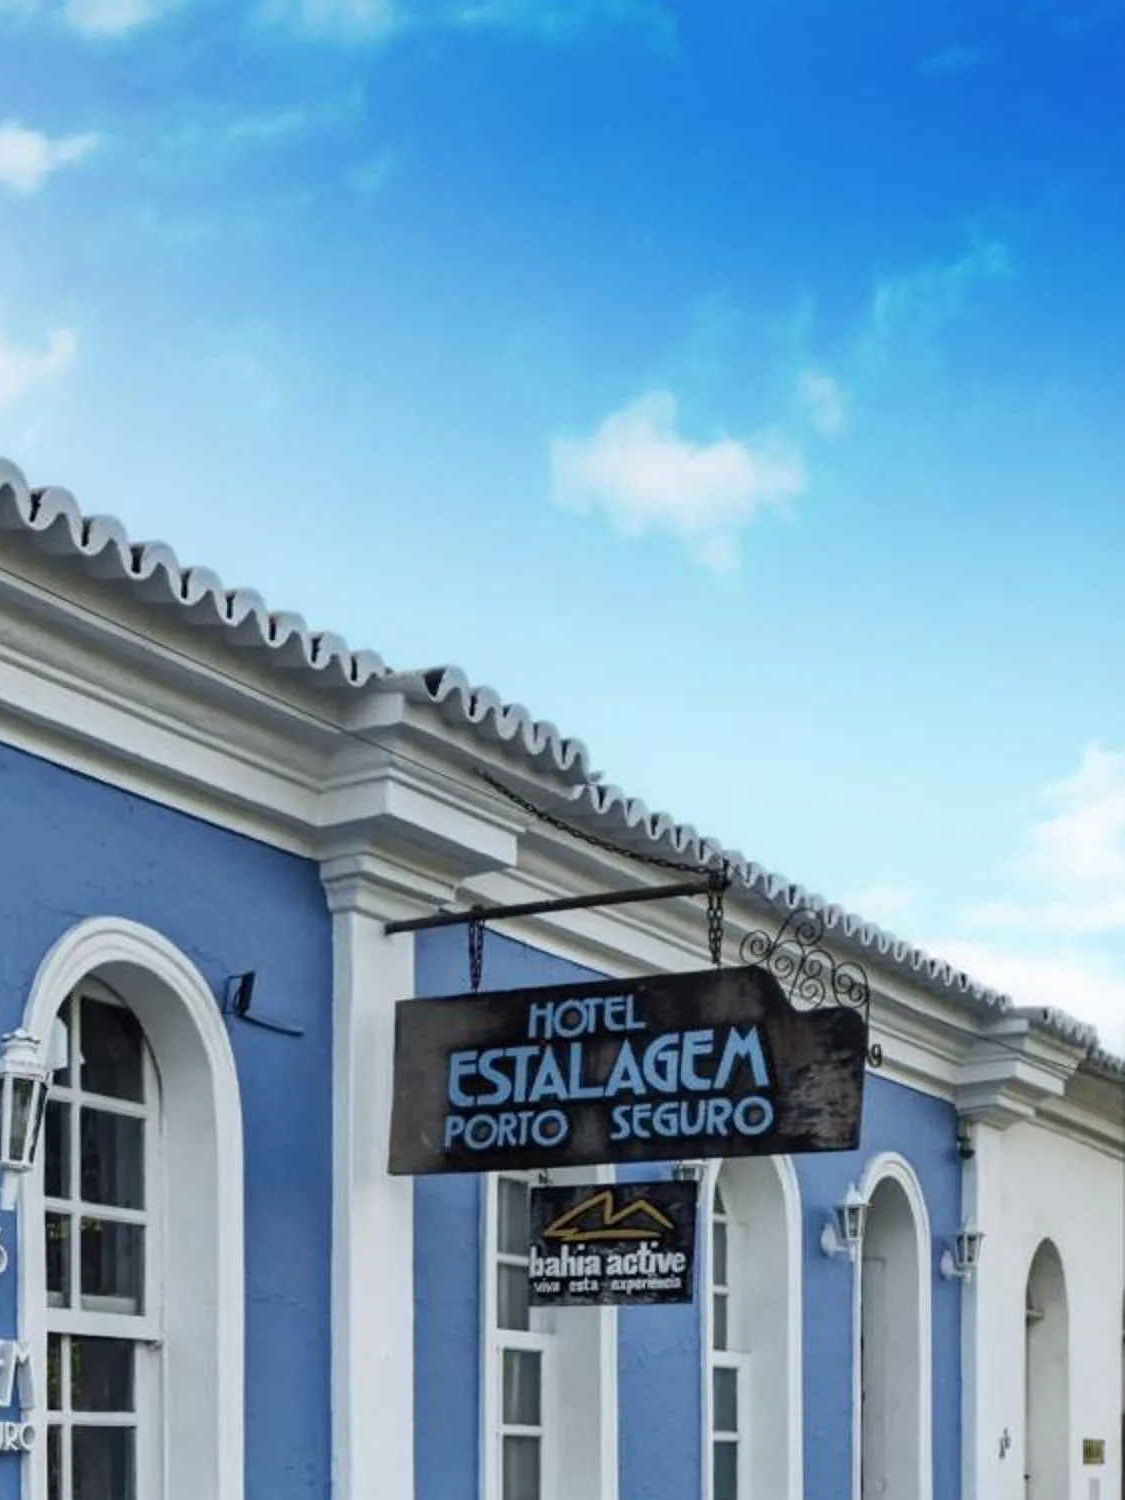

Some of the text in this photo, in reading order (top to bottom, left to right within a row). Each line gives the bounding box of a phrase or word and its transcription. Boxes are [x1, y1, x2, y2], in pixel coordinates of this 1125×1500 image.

[528, 994, 646, 1039] HOTEL
[447, 1024, 771, 1108] ESTALAGEM
[444, 1096, 775, 1150] PORTO SEGURO
[529, 1241, 687, 1278] bahia active
[534, 1278, 561, 1293] viva
[568, 1277, 599, 1293] esta
